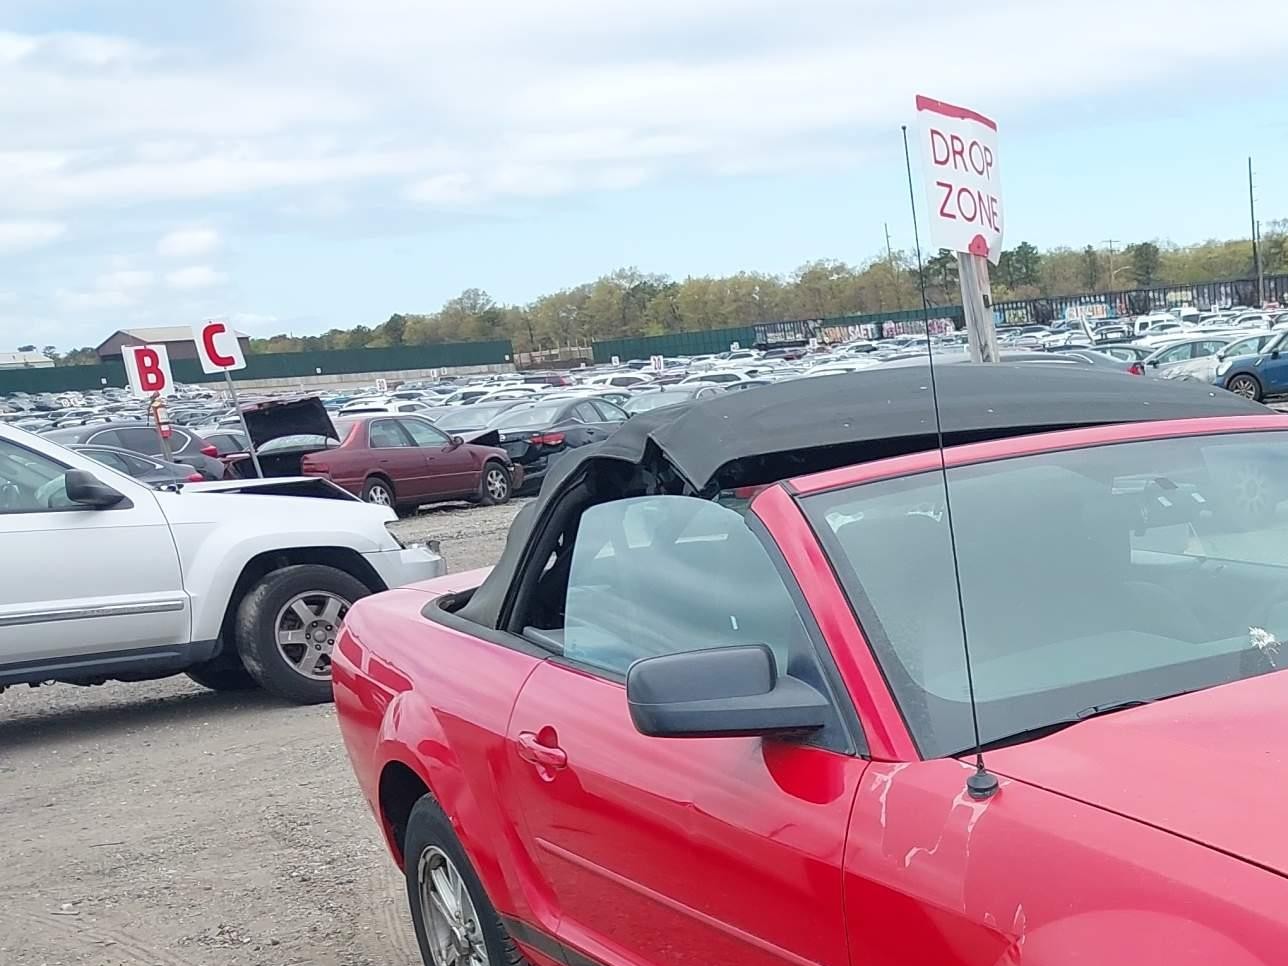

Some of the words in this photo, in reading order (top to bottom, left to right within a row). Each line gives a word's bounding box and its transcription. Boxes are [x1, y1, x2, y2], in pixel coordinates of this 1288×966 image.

[930, 128, 993, 181] DROP
[936, 180, 1001, 233] ZONE
[134, 348, 166, 392] B
[202, 323, 236, 368] C
